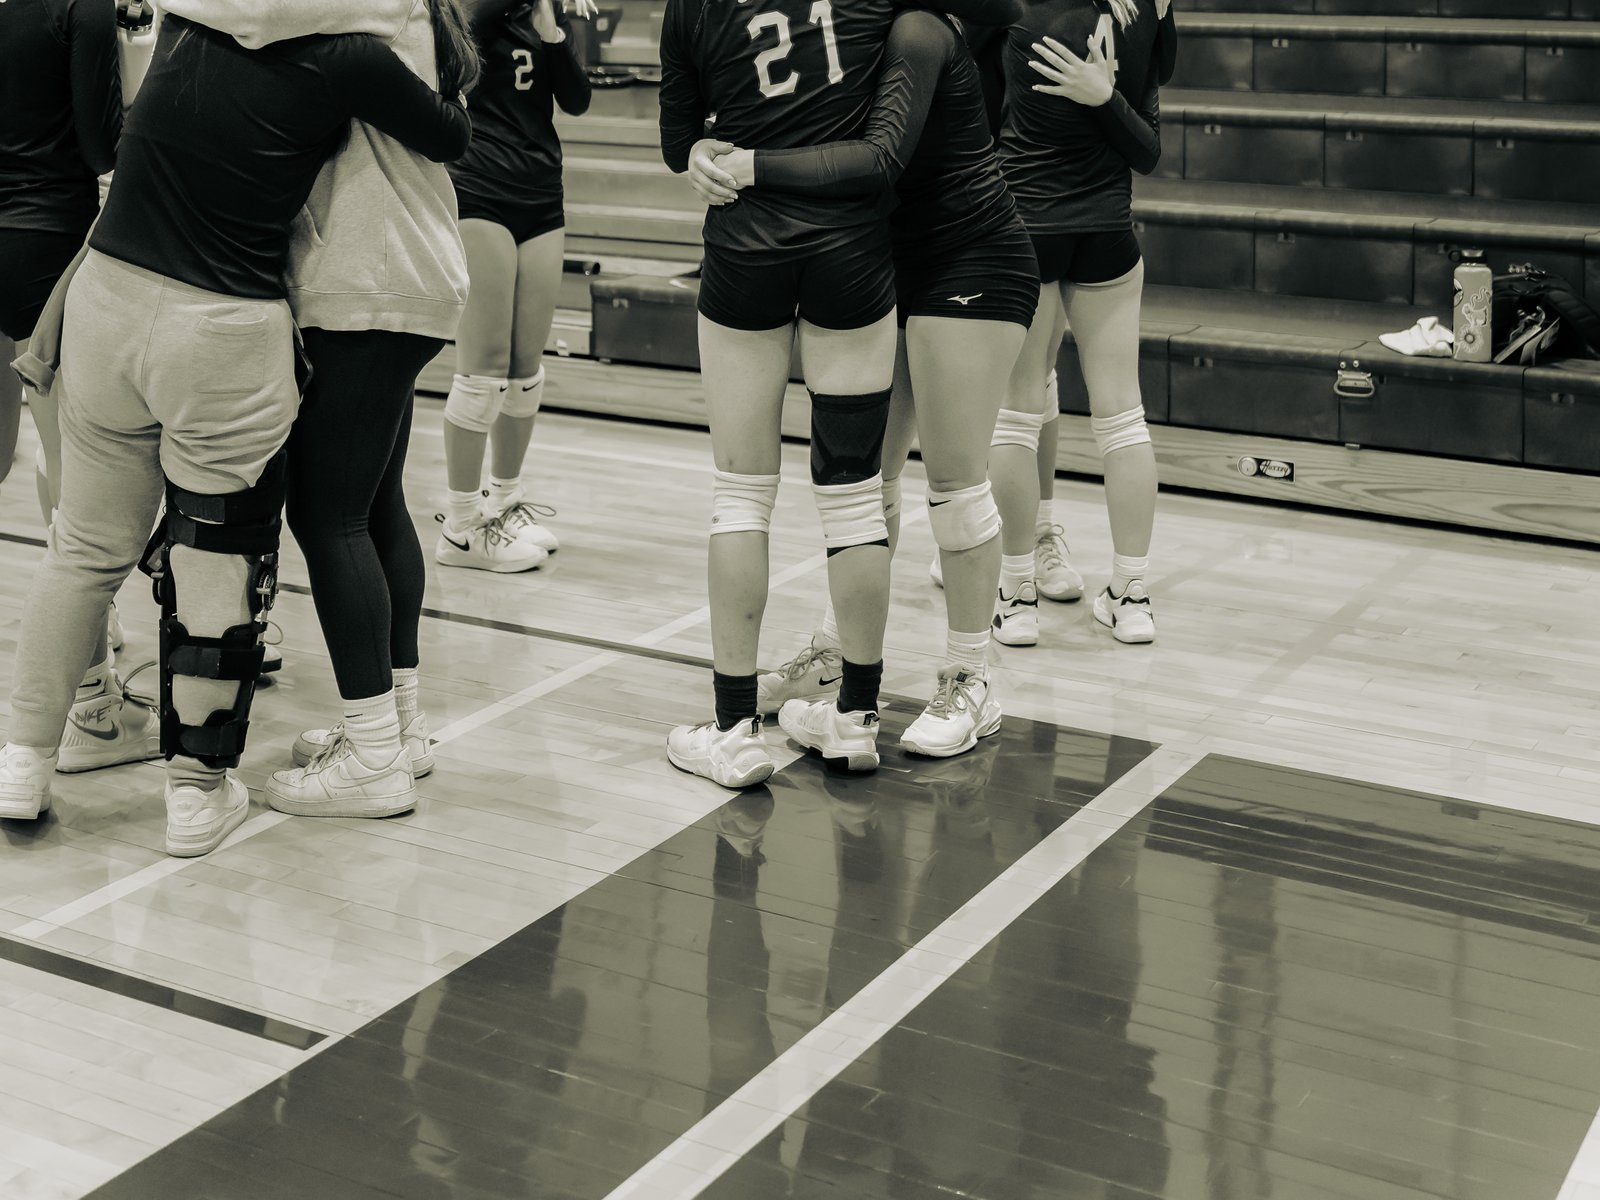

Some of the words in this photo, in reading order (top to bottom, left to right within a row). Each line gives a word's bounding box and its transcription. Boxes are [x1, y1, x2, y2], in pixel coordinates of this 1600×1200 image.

[511, 49, 534, 91] 2
[747, 0, 844, 98] 21
[1085, 13, 1119, 88] 4
